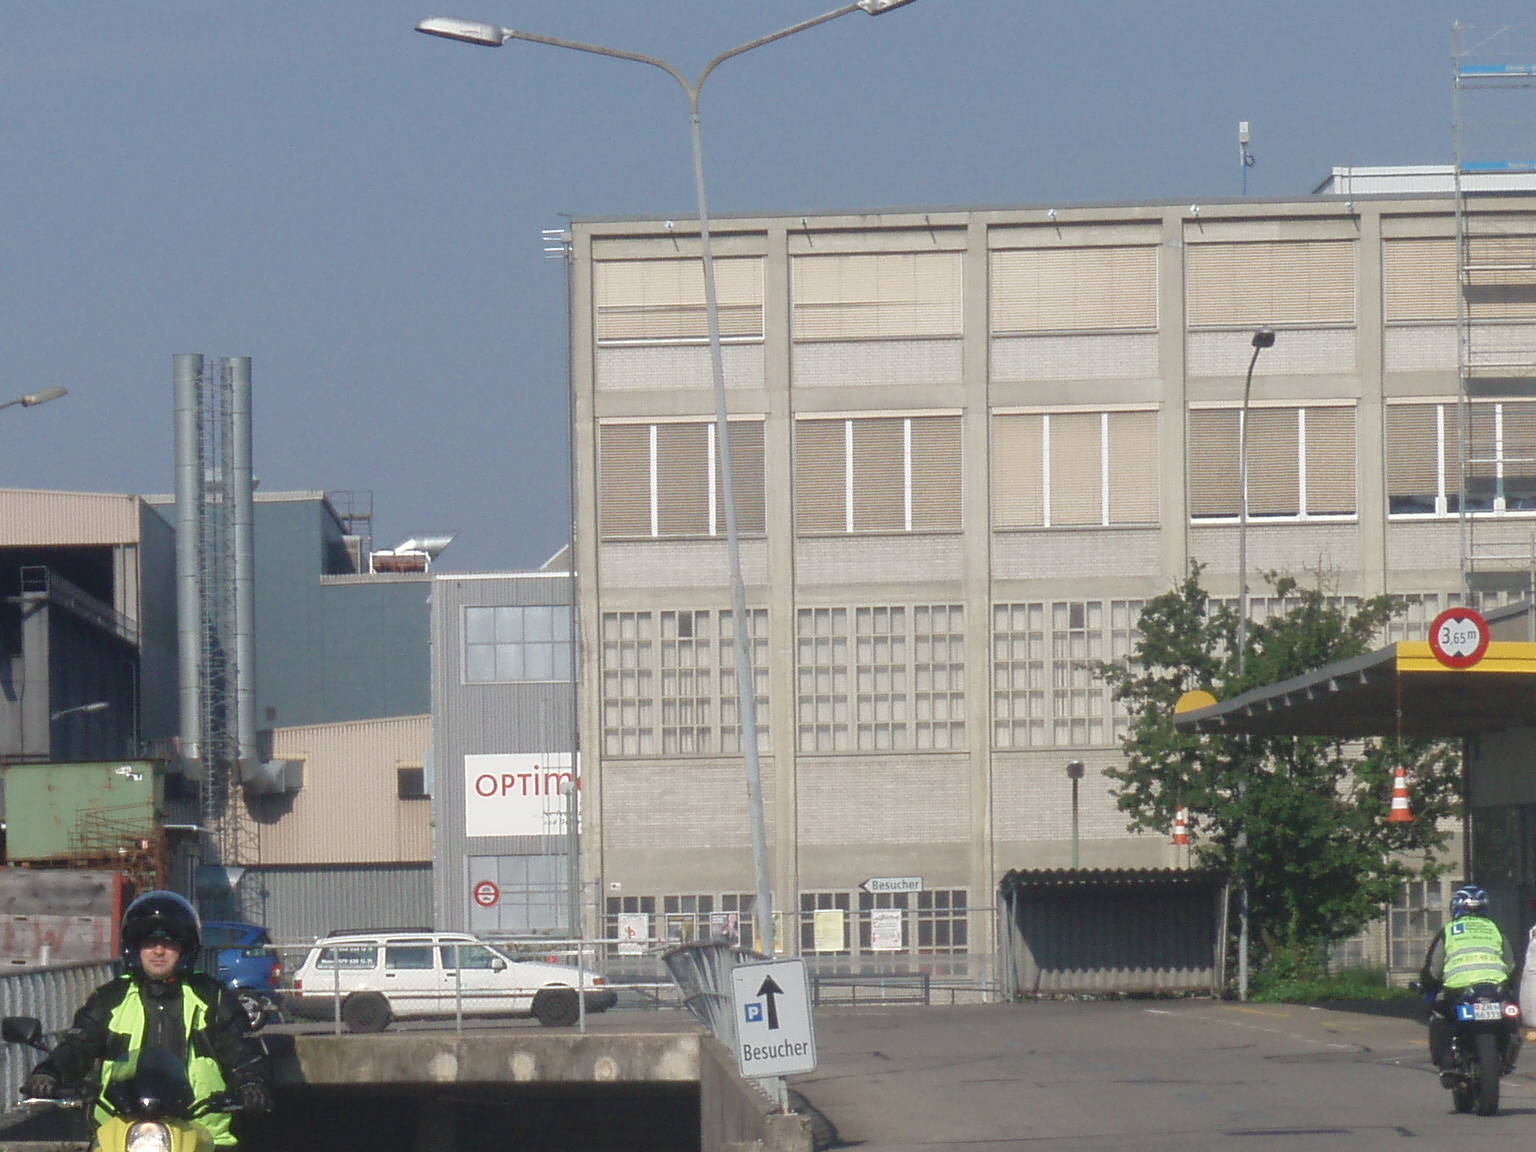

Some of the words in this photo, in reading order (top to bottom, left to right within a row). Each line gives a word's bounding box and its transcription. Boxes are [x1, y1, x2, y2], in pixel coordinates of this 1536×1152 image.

[872, 880, 919, 891] Besucher
[1453, 925, 1462, 934] L
[748, 1006, 759, 1020] P
[1462, 1007, 1473, 1018] L
[743, 1039, 808, 1062] Besucher
